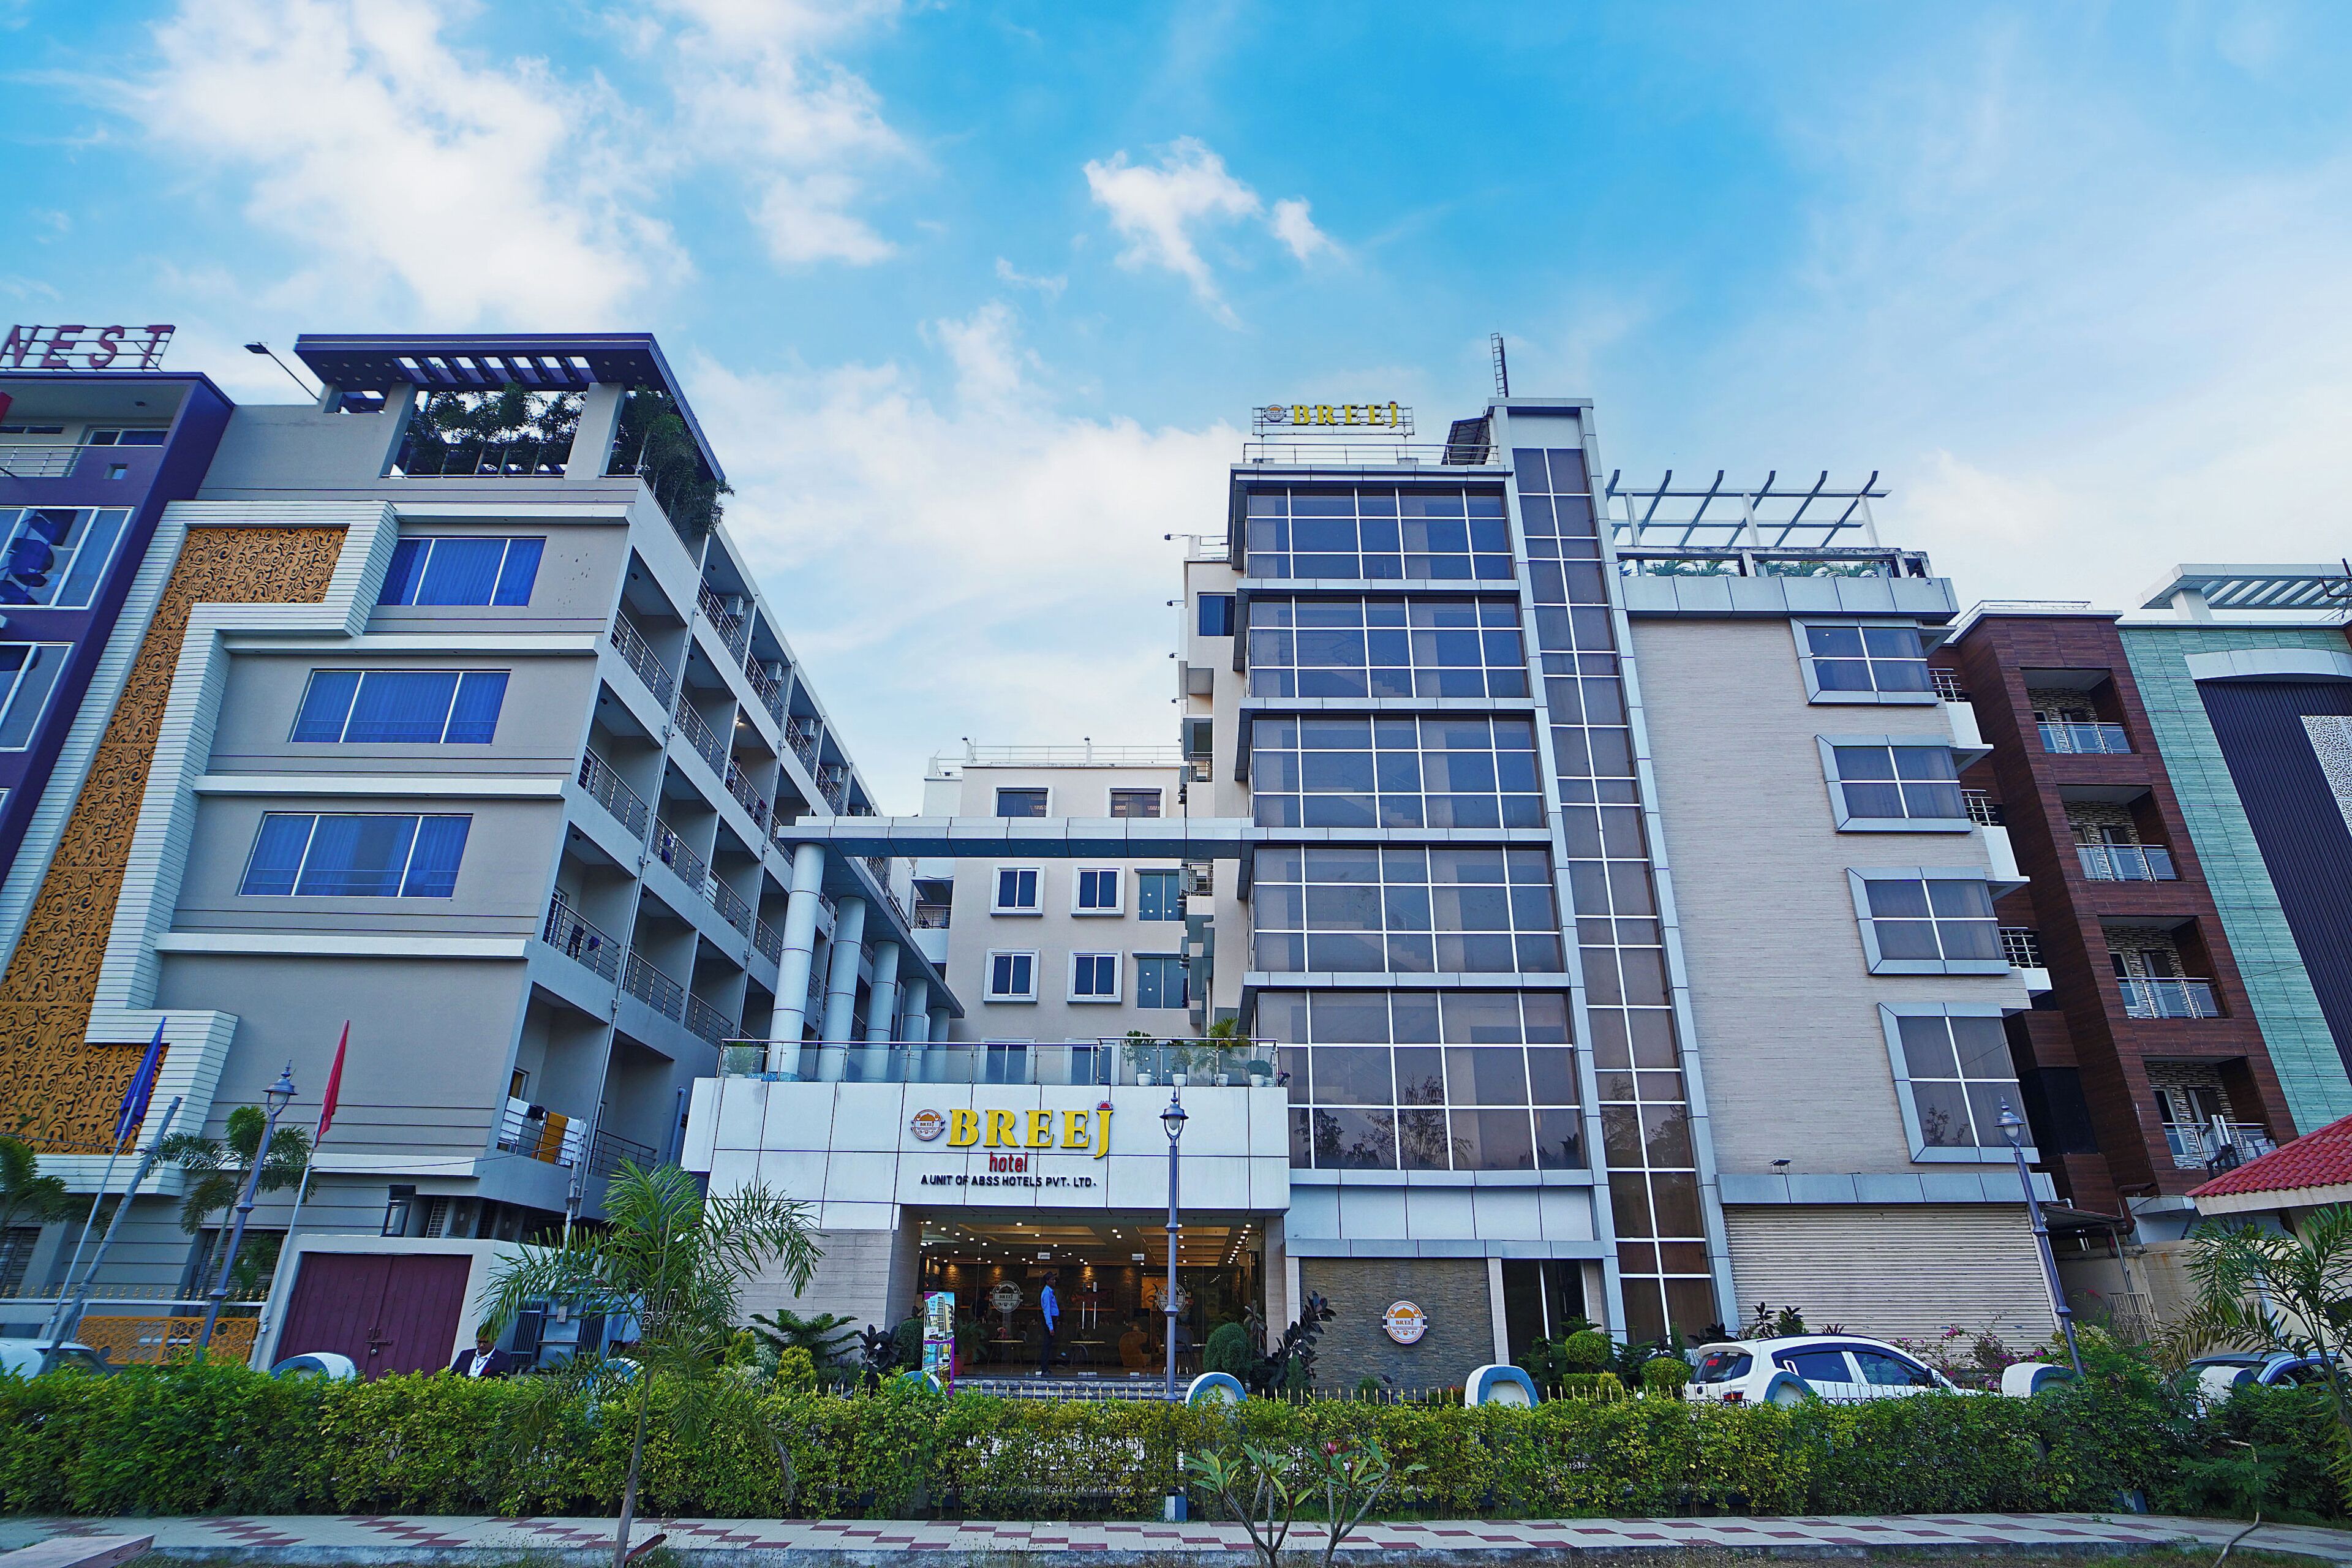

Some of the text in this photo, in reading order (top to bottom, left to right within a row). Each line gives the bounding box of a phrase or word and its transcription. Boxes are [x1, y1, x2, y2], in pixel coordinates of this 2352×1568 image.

[0, 325, 176, 368] NEST
[1291, 403, 1398, 428] BREEJ
[946, 1106, 1114, 1159] BREEJ
[989, 1152, 1028, 1172] hotel
[921, 1175, 1097, 1187] A UNIT OF ABSS HOTELS PVT. LTD.
